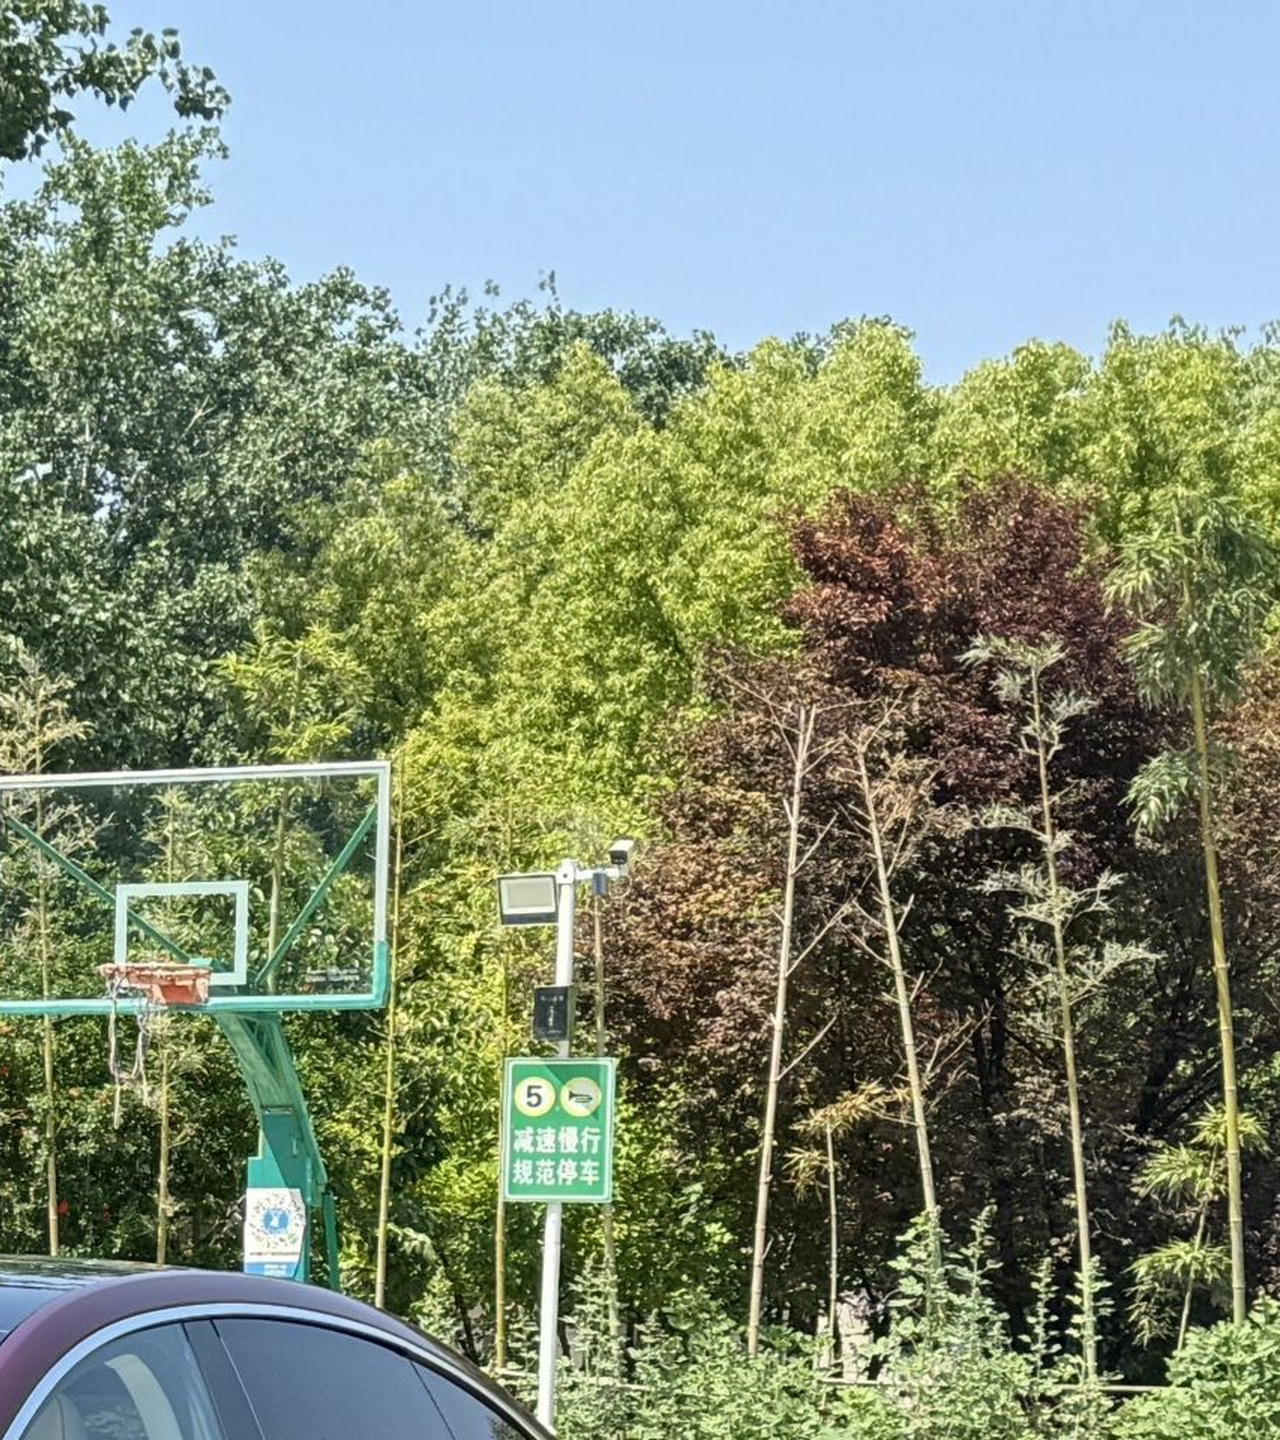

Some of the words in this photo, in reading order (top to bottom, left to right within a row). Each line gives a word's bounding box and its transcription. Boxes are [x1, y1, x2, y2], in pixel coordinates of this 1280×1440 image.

[526, 1085, 543, 1108] 5
[513, 1126, 602, 1154] 减速慢行
[512, 1159, 600, 1186] 规范停车
